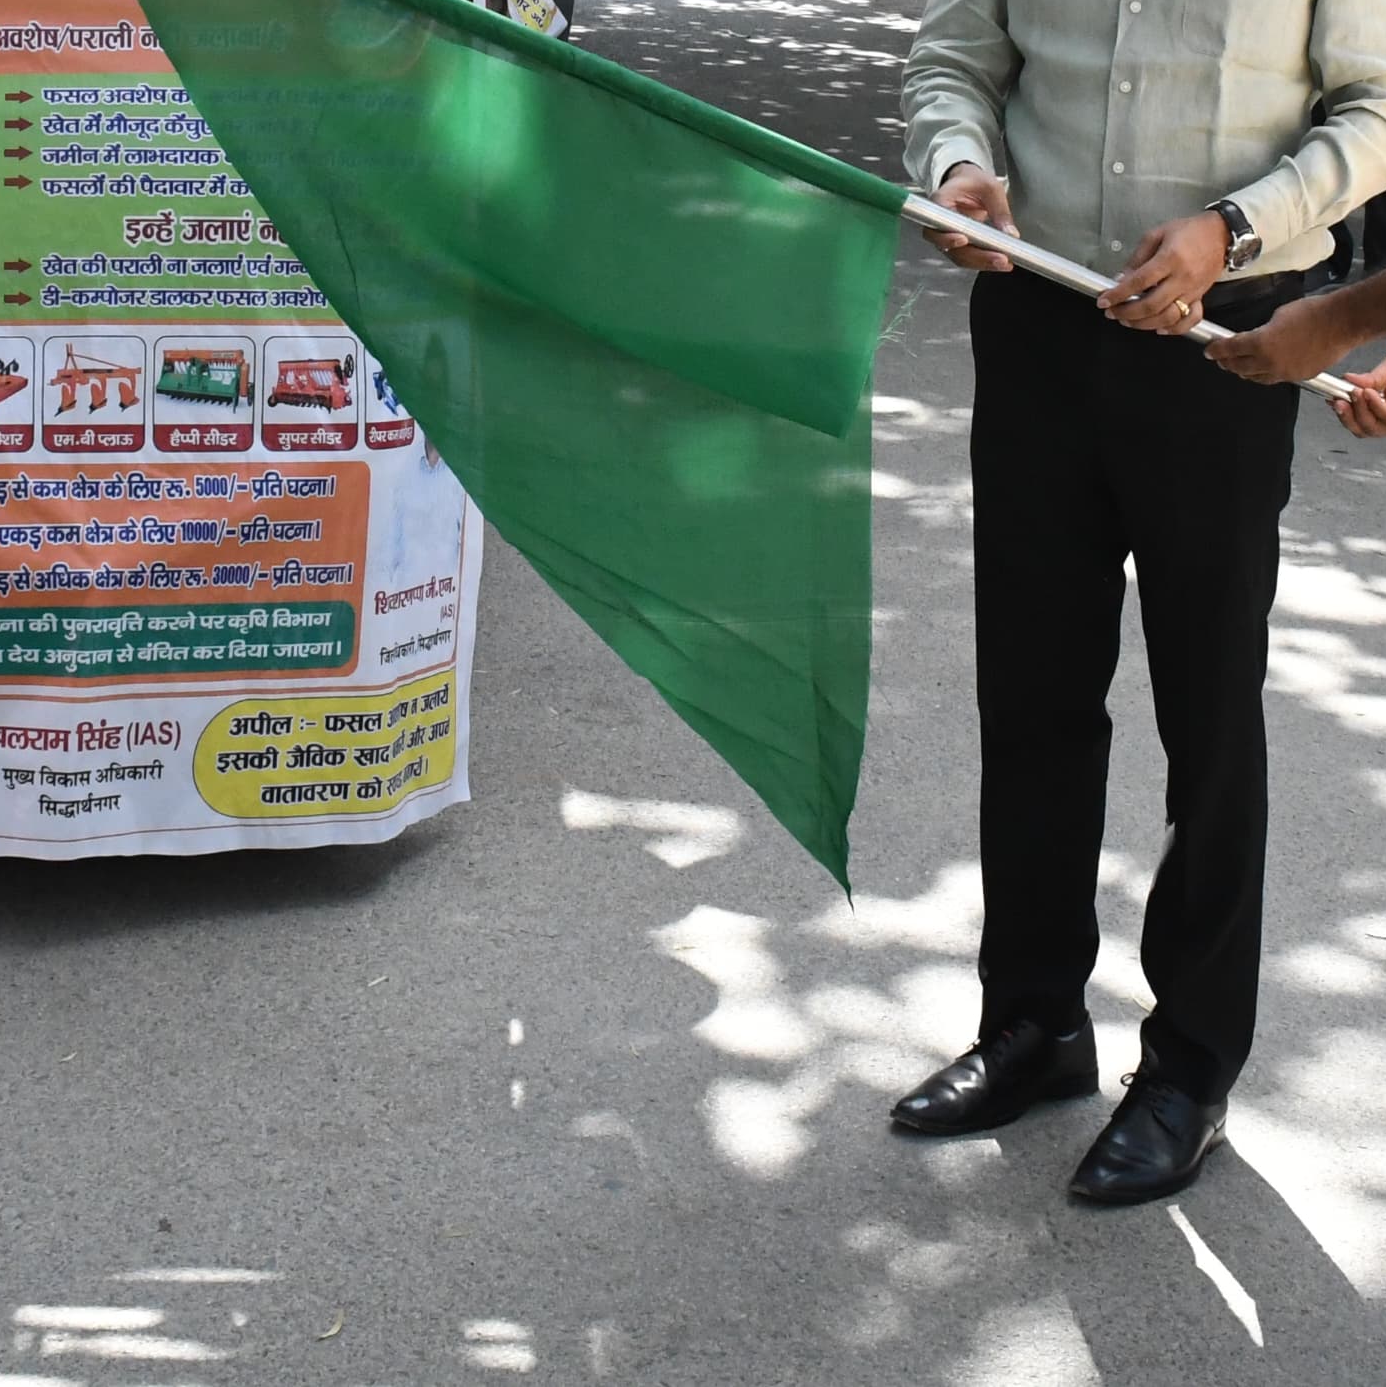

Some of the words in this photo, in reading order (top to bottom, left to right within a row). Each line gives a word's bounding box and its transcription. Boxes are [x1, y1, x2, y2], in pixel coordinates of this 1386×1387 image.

[43, 88, 99, 104] फसल
[104, 85, 167, 104] अवशेष
[43, 115, 79, 135] खेत
[84, 113, 101, 133] में
[106, 113, 160, 139] मौजूद
[42, 144, 98, 164] जमीन
[104, 144, 121, 164] में
[124, 149, 221, 164] लाभदायक
[43, 174, 105, 195] फसलों
[109, 175, 135, 195] की
[140, 175, 206, 195] पैदावार
[209, 174, 226, 195] में
[125, 211, 173, 243] इन्हें
[182, 212, 252, 242] जलाएं
[42, 256, 77, 275] खेत
[81, 254, 106, 274] की
[112, 254, 163, 274] पराली
[166, 259, 187, 274] ना
[191, 255, 244, 275] जलाएं
[247, 255, 271, 274] एवं
[150, 290, 213, 305] डालकर
[216, 290, 265, 306] फसल
[270, 287, 326, 307] अवशेष
[170, 428, 199, 446] हैप्पी
[204, 429, 237, 445] सीडर
[278, 432, 307, 449] सुपर
[310, 428, 343, 445] सीडर
[12, 474, 29, 498] से
[33, 481, 67, 498] कम
[71, 474, 101, 498] क्षेत्र
[104, 474, 123, 498] के
[127, 473, 162, 499] लिए
[252, 472, 282, 500] प्रति
[46, 526, 81, 543] कम
[85, 520, 114, 543] क्षेत्र
[118, 519, 138, 542] के
[142, 518, 176, 543] लिए
[240, 517, 269, 544] प्रति
[14, 566, 30, 589] से
[34, 564, 92, 589] अधिक
[95, 563, 125, 588] क्षेत्र
[128, 564, 148, 588] के
[150, 563, 181, 588] लिए
[273, 559, 301, 587] प्रति
[28, 613, 58, 632] की
[63, 612, 144, 641] पुनरावृत्ति
[147, 611, 196, 631] करने
[200, 615, 226, 629] पर
[228, 608, 269, 634] कृषि
[272, 608, 332, 628] विभाग
[7, 644, 39, 663] देय
[44, 648, 113, 672] अनुदान
[115, 643, 135, 663] से
[193, 645, 226, 660] कर
[228, 639, 269, 658] दिया
[76, 719, 124, 752] सिंह
[126, 721, 181, 752] (IAS)
[229, 712, 293, 737] अपील
[324, 713, 382, 733] फसल
[217, 747, 279, 773] इसकी
[287, 745, 346, 768] जैविक
[354, 746, 390, 766] खाद
[2, 767, 35, 789] मुख्य
[40, 766, 91, 787] विकास
[95, 759, 164, 783] अधिकारी
[262, 782, 350, 804] वातावरण
[357, 776, 383, 800] को
[38, 793, 121, 818] सिद्धार्थनगर
